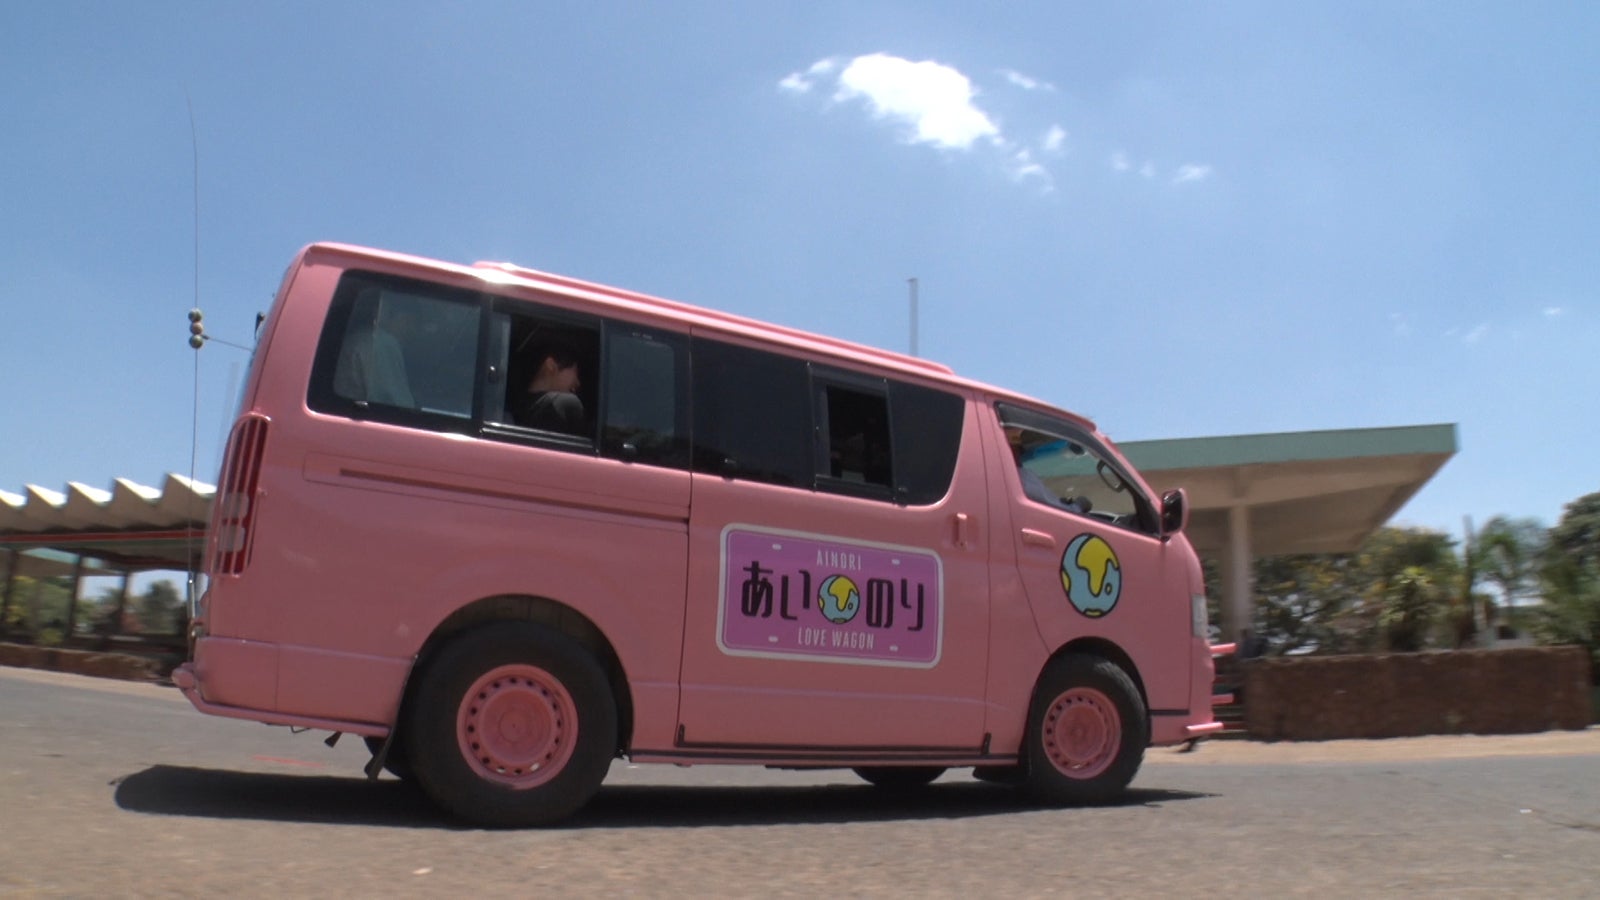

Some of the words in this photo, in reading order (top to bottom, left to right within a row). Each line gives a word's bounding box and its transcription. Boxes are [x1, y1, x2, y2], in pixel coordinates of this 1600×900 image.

[816, 550, 862, 571] AINORI
[798, 627, 826, 647] LOVE
[832, 630, 874, 650] WAGON
